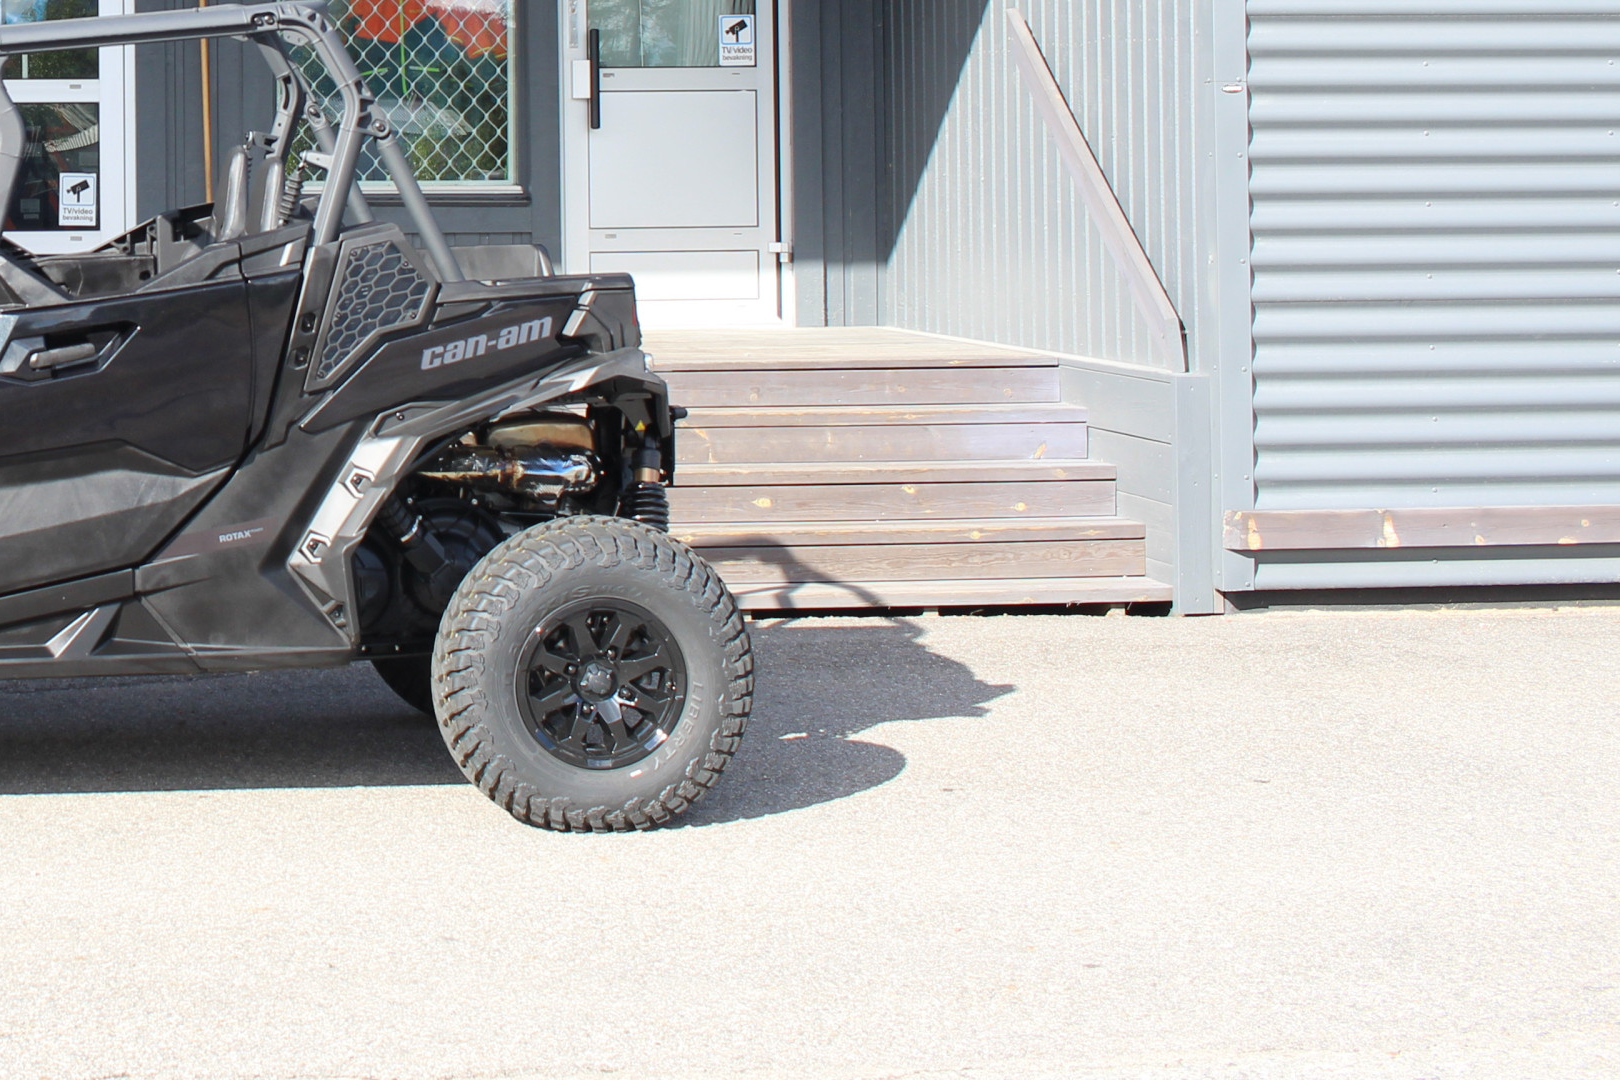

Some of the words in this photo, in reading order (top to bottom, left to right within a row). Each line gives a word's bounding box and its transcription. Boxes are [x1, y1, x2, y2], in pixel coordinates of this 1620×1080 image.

[63, 207, 94, 215] TV/video
[62, 215, 94, 223] bevakning
[421, 316, 553, 371] can-am
[219, 529, 251, 543] ROTAX
[653, 681, 703, 770] LIBERTY
